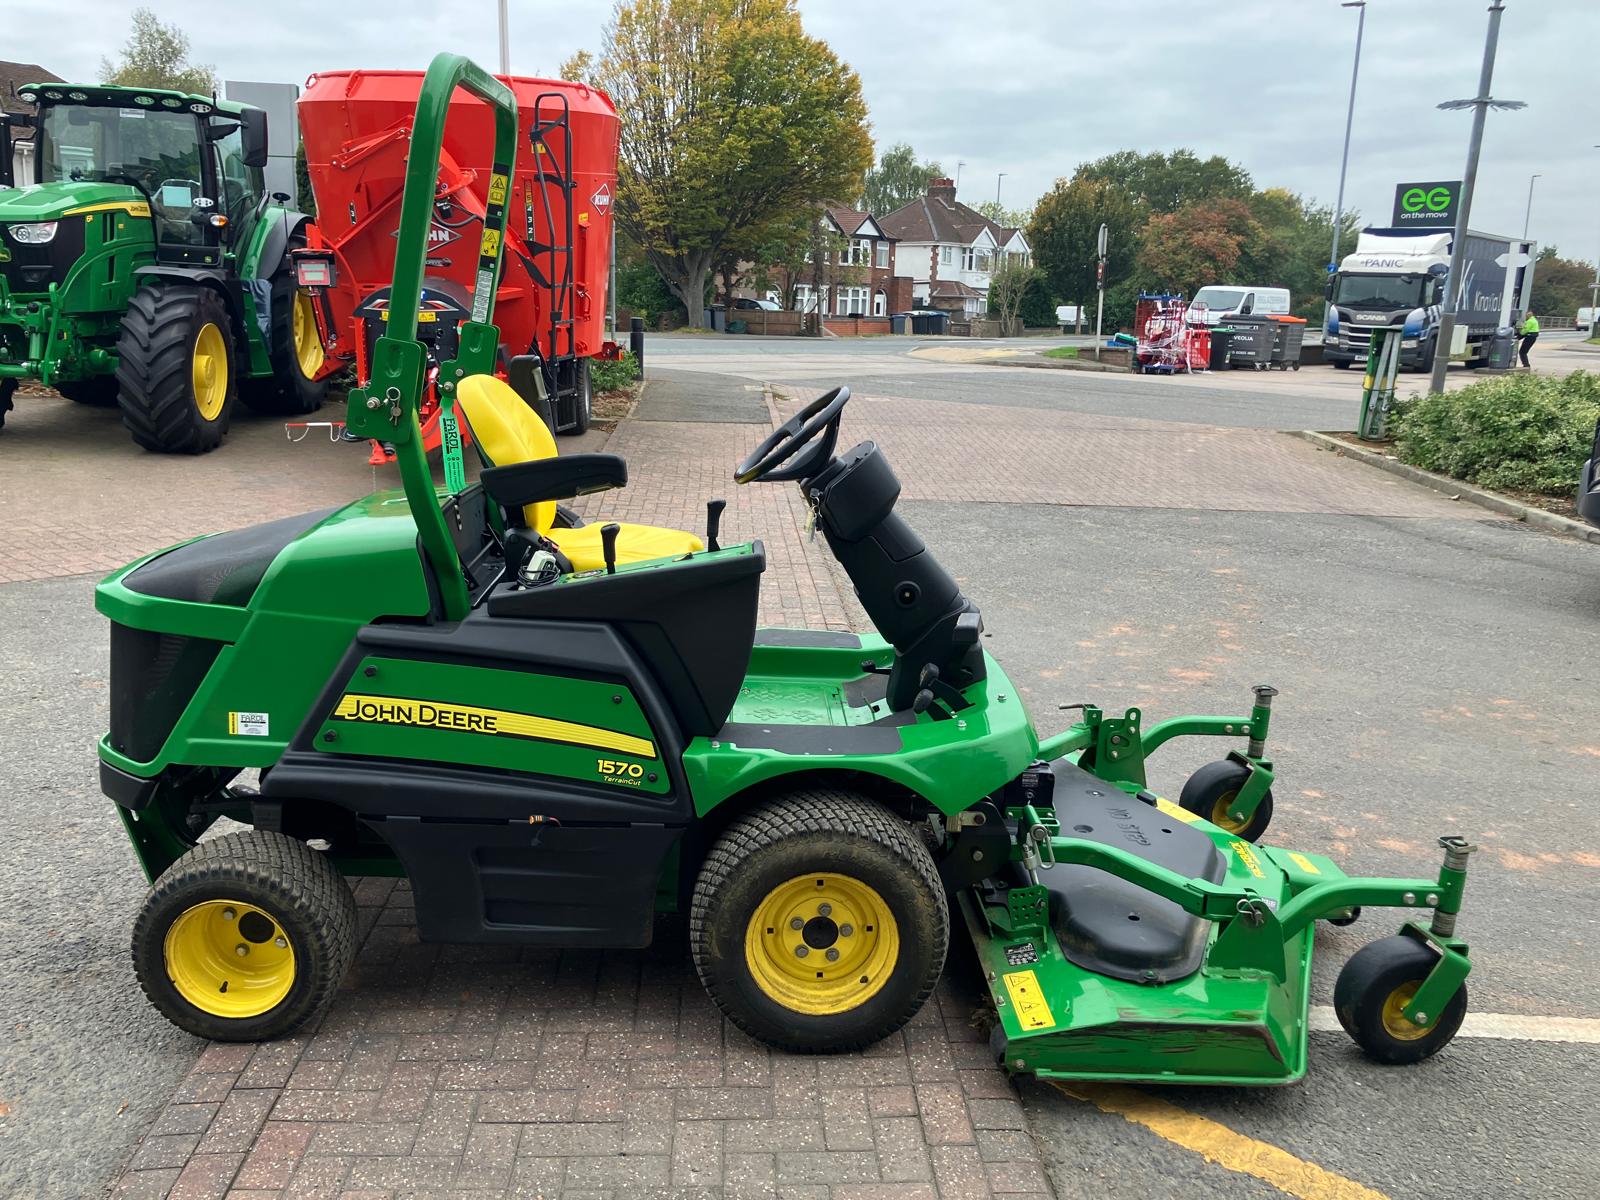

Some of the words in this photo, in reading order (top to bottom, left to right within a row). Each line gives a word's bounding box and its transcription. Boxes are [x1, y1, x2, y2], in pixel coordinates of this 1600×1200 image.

[428, 230, 450, 241] HN
[347, 699, 413, 722] JOHN
[418, 704, 498, 732] DEERE
[597, 759, 644, 778] 1570
[603, 775, 642, 786] TerrainCut
